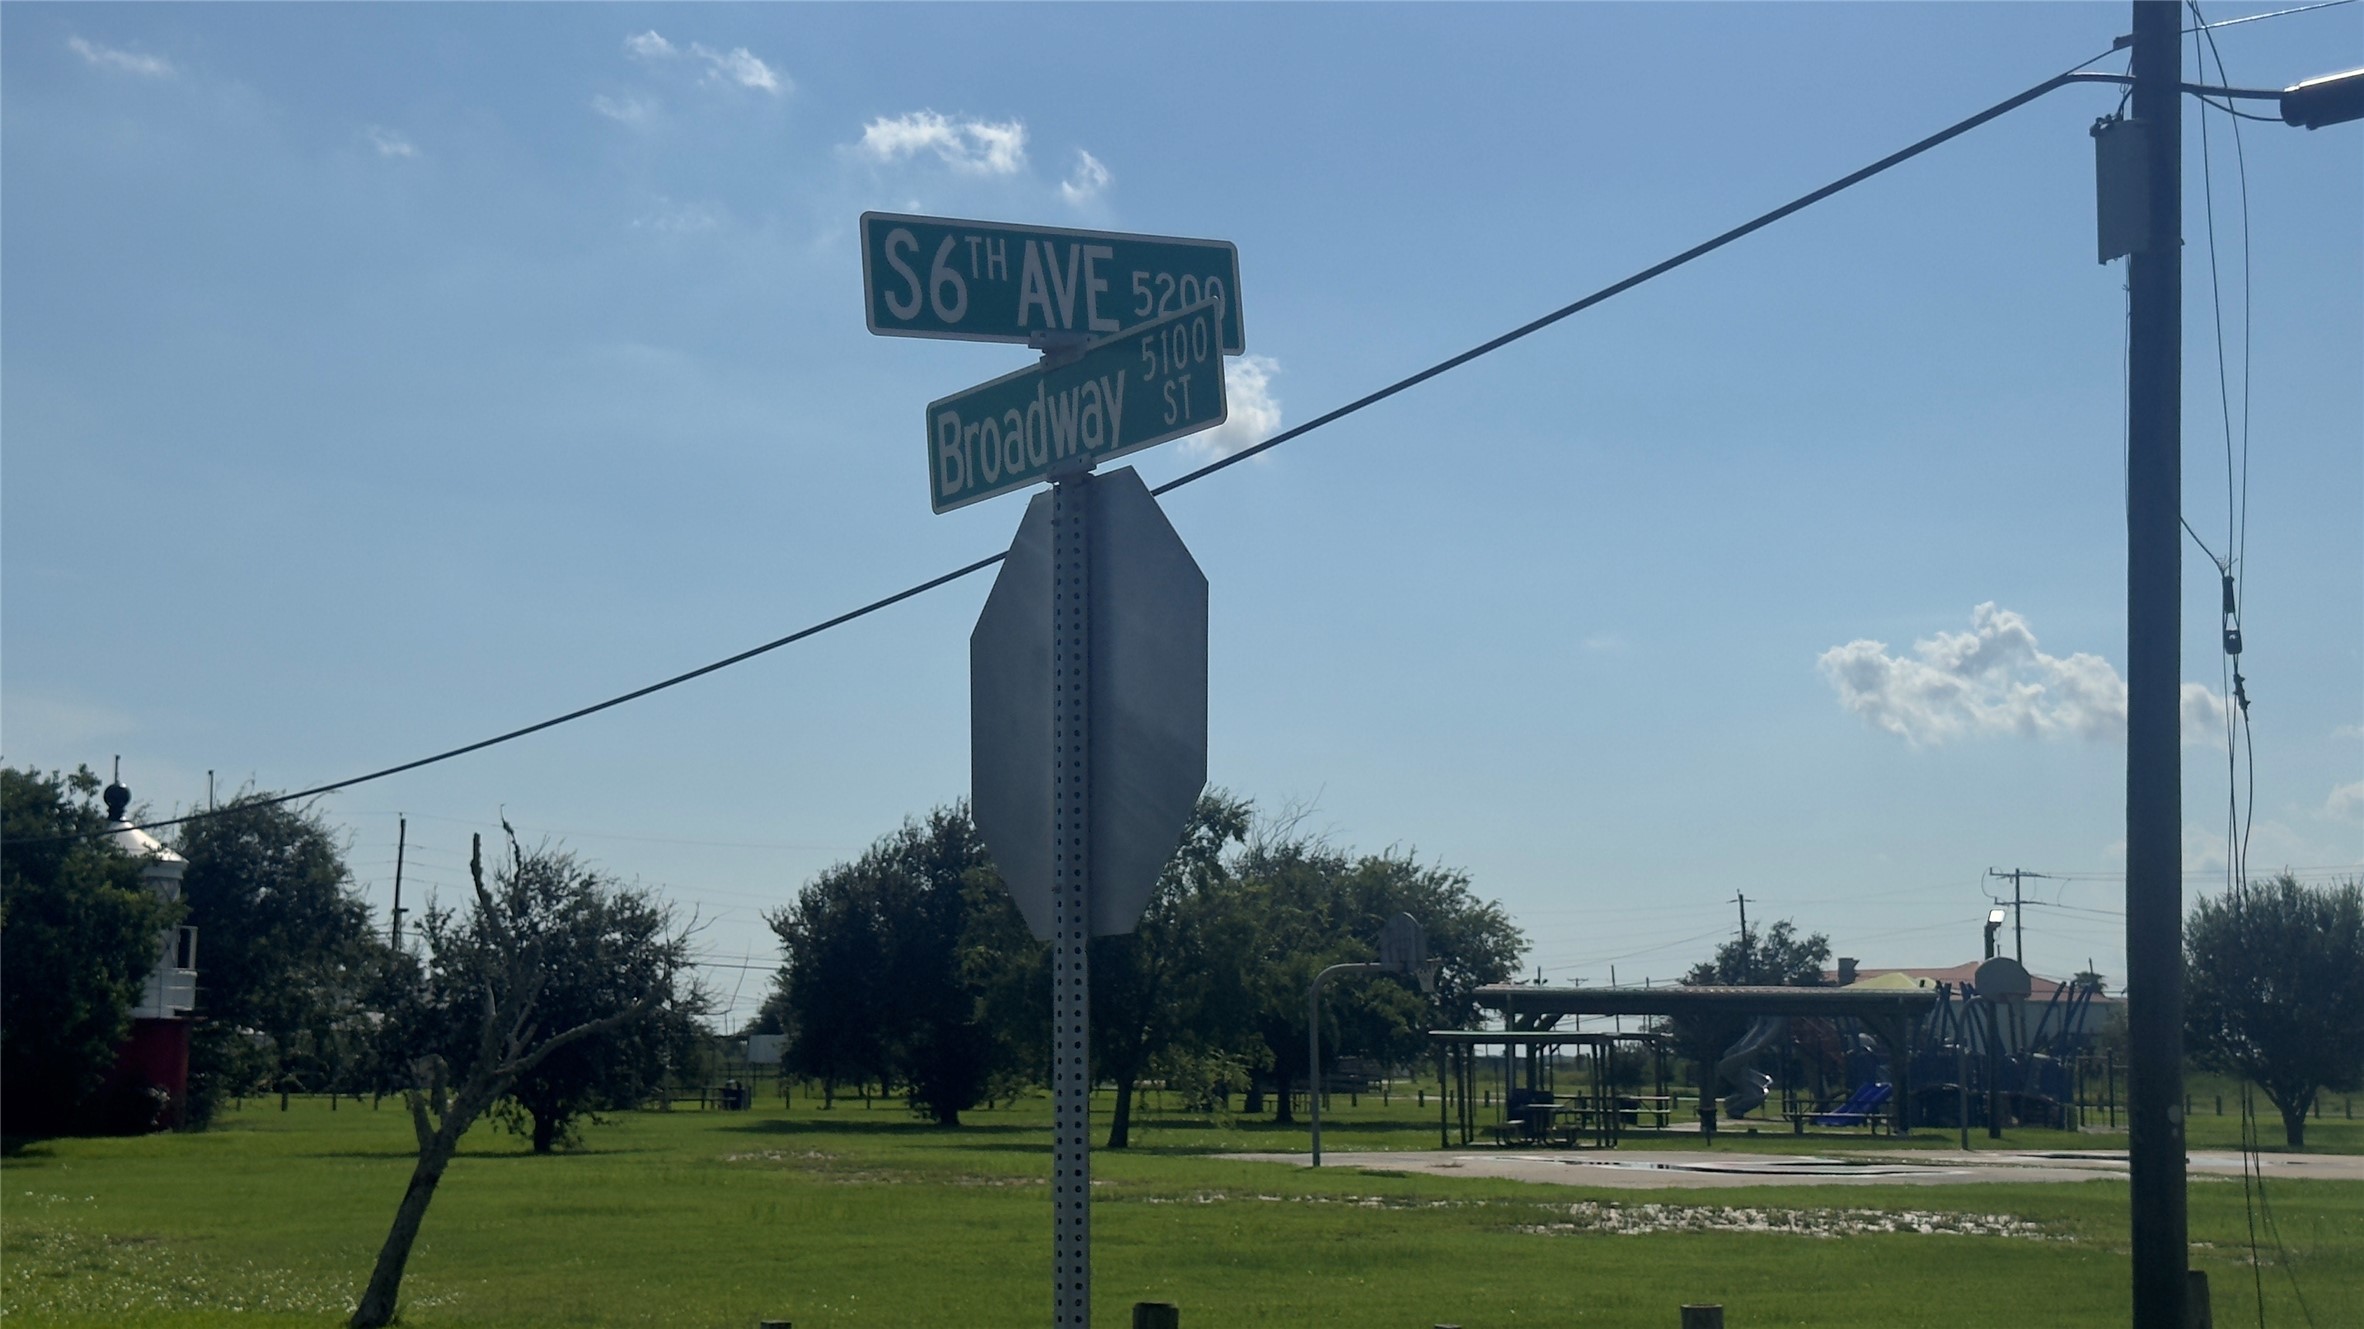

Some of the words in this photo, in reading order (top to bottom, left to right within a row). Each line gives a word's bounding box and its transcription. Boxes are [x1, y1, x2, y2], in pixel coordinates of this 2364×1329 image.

[1017, 240, 1120, 332] AVE
[1132, 271, 1226, 320] 5200
[1142, 316, 1207, 381] 5100
[937, 369, 1126, 497] Broadway
[1163, 374, 1192, 425] ST
